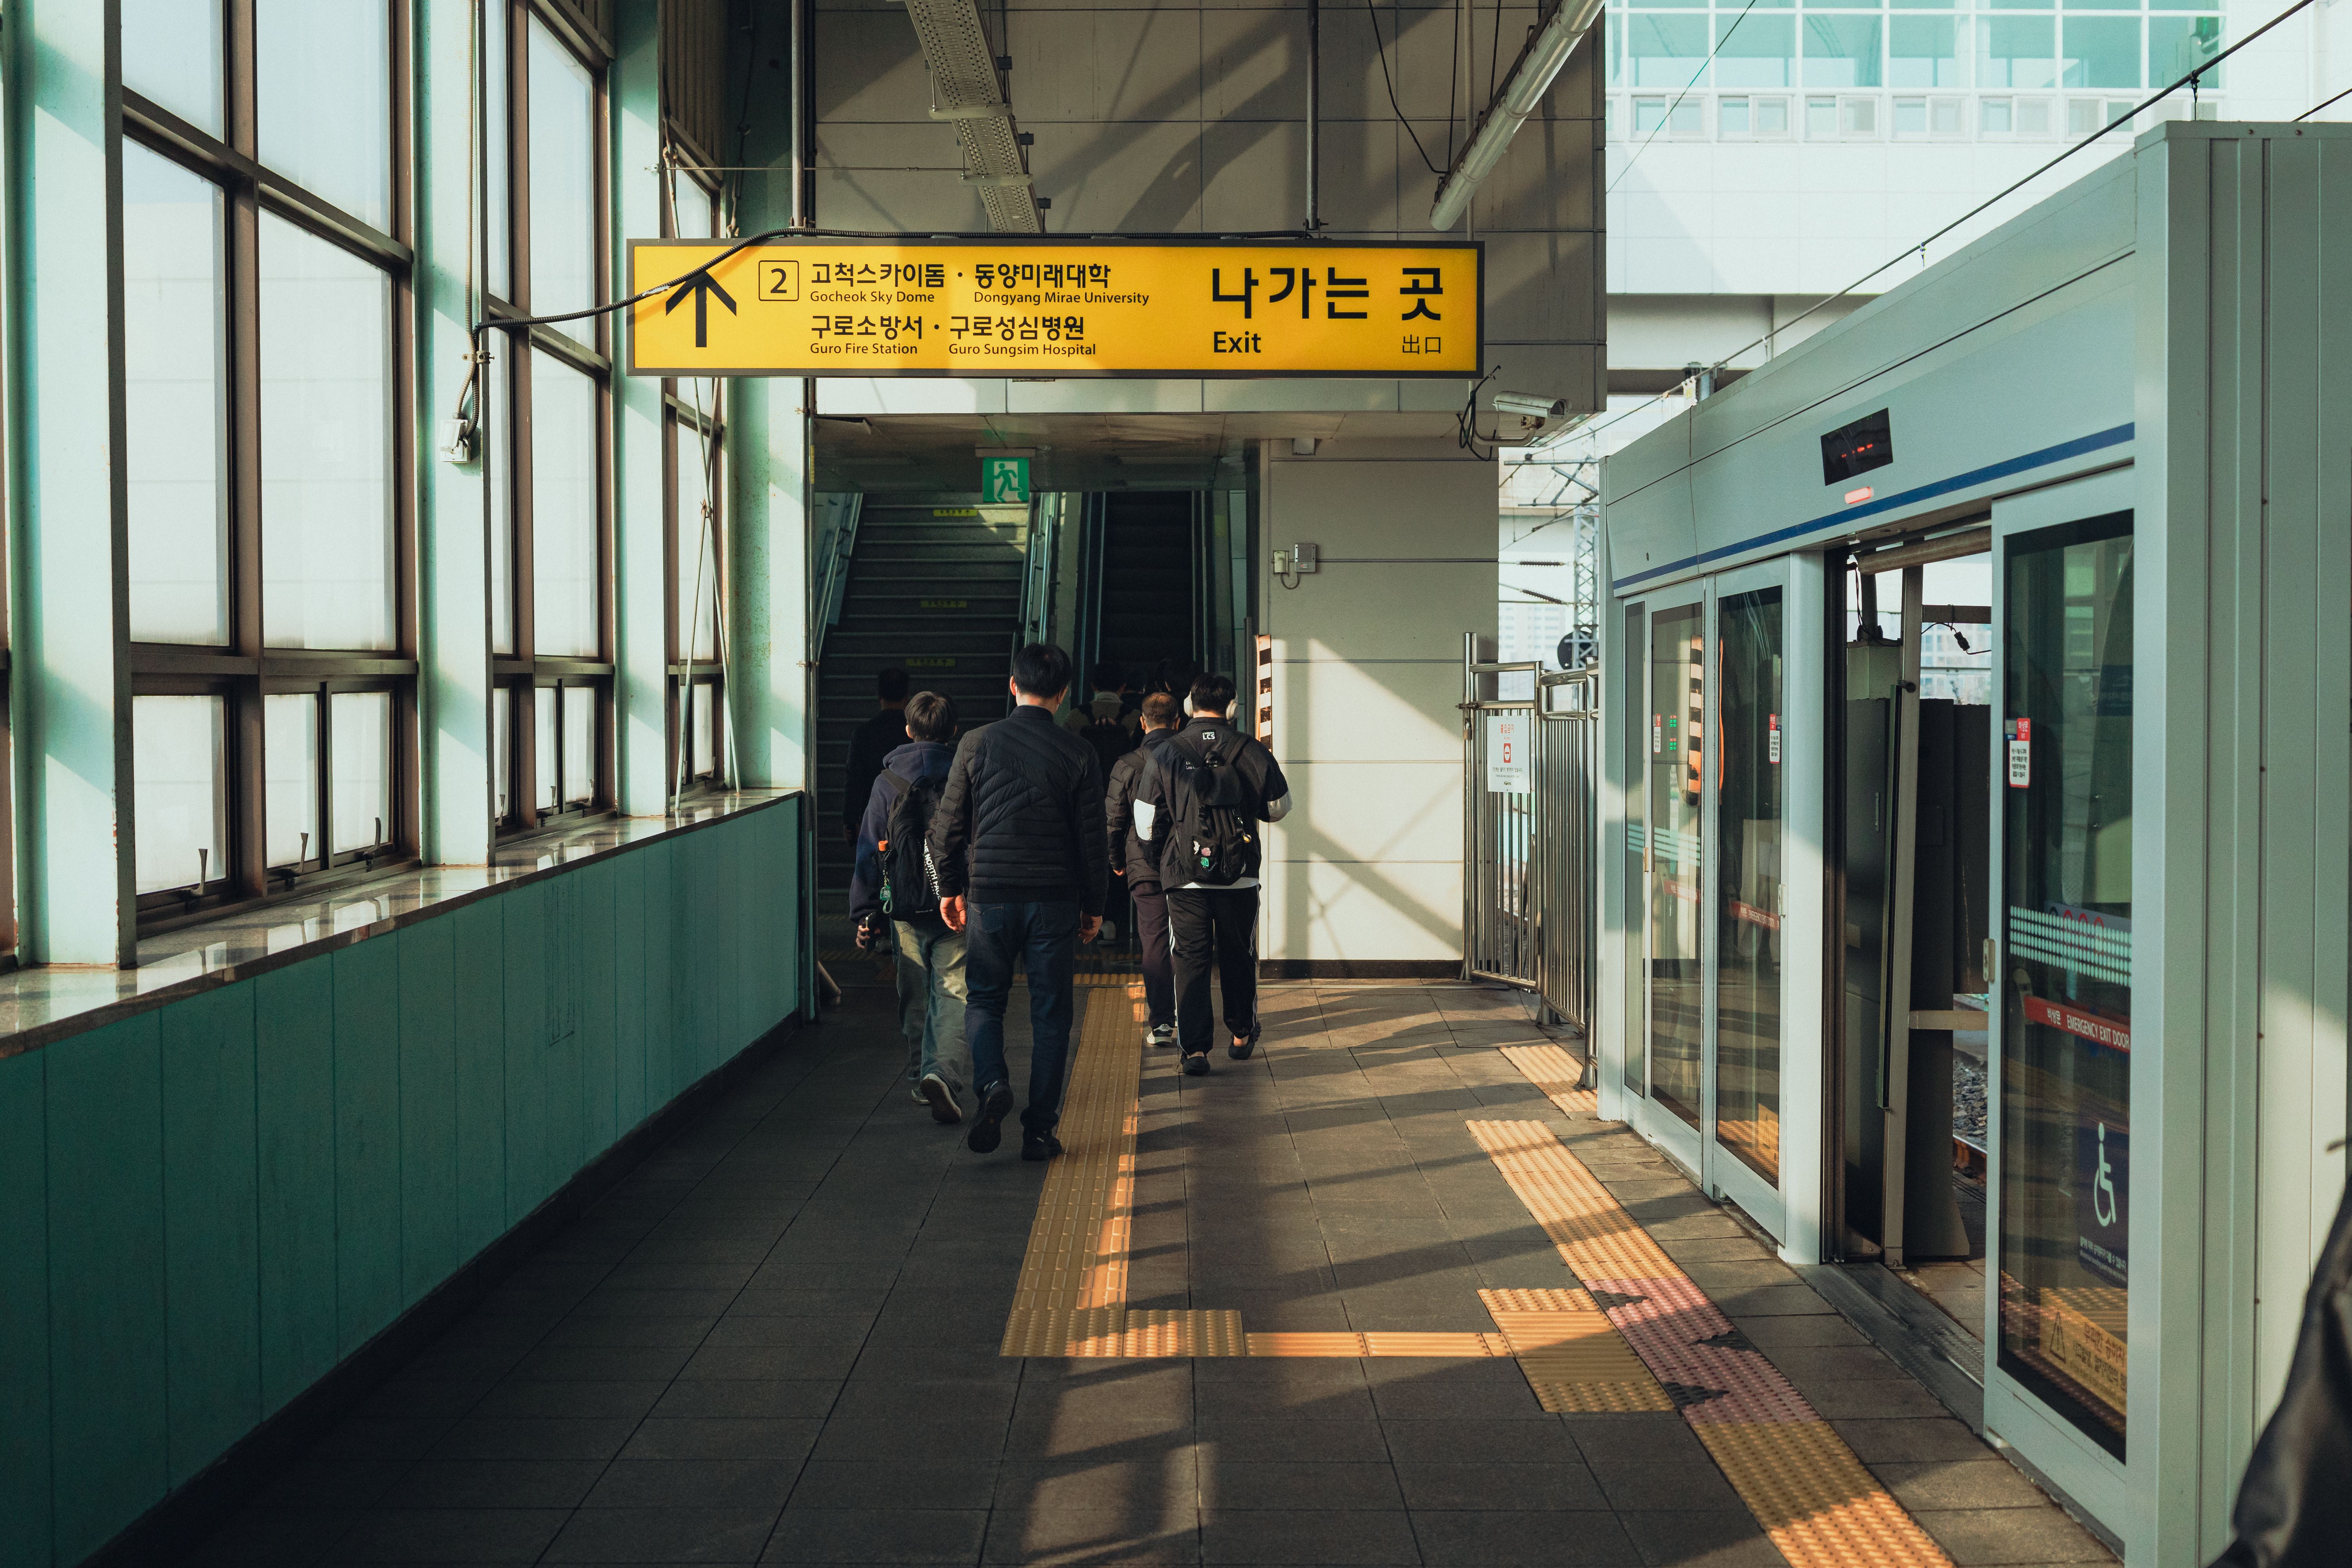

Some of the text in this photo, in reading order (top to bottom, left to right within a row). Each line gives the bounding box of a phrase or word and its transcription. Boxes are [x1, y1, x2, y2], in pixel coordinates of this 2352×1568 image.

[770, 268, 787, 294] 2
[811, 262, 1111, 289] 고척스카이돔 동양미래대학
[810, 290, 935, 305] Gocheok Sky Dome
[974, 292, 1149, 306] Dongyang Mirae University
[1212, 267, 1444, 321] 나가는 곳
[811, 316, 1084, 341] 구로소방서 구로성심병원
[810, 343, 918, 354] Guro Fire Station
[949, 343, 1096, 358] Guro Sungsim Hospital
[1213, 331, 1261, 354] Exit
[1402, 334, 1441, 355] 出口
[1501, 724, 1514, 733] 출입금지
[924, 853, 938, 880] NORTH
[2047, 1007, 2061, 1025] 비상문
[2066, 1014, 2130, 1050] EMERGENCY EXIT DOOR
